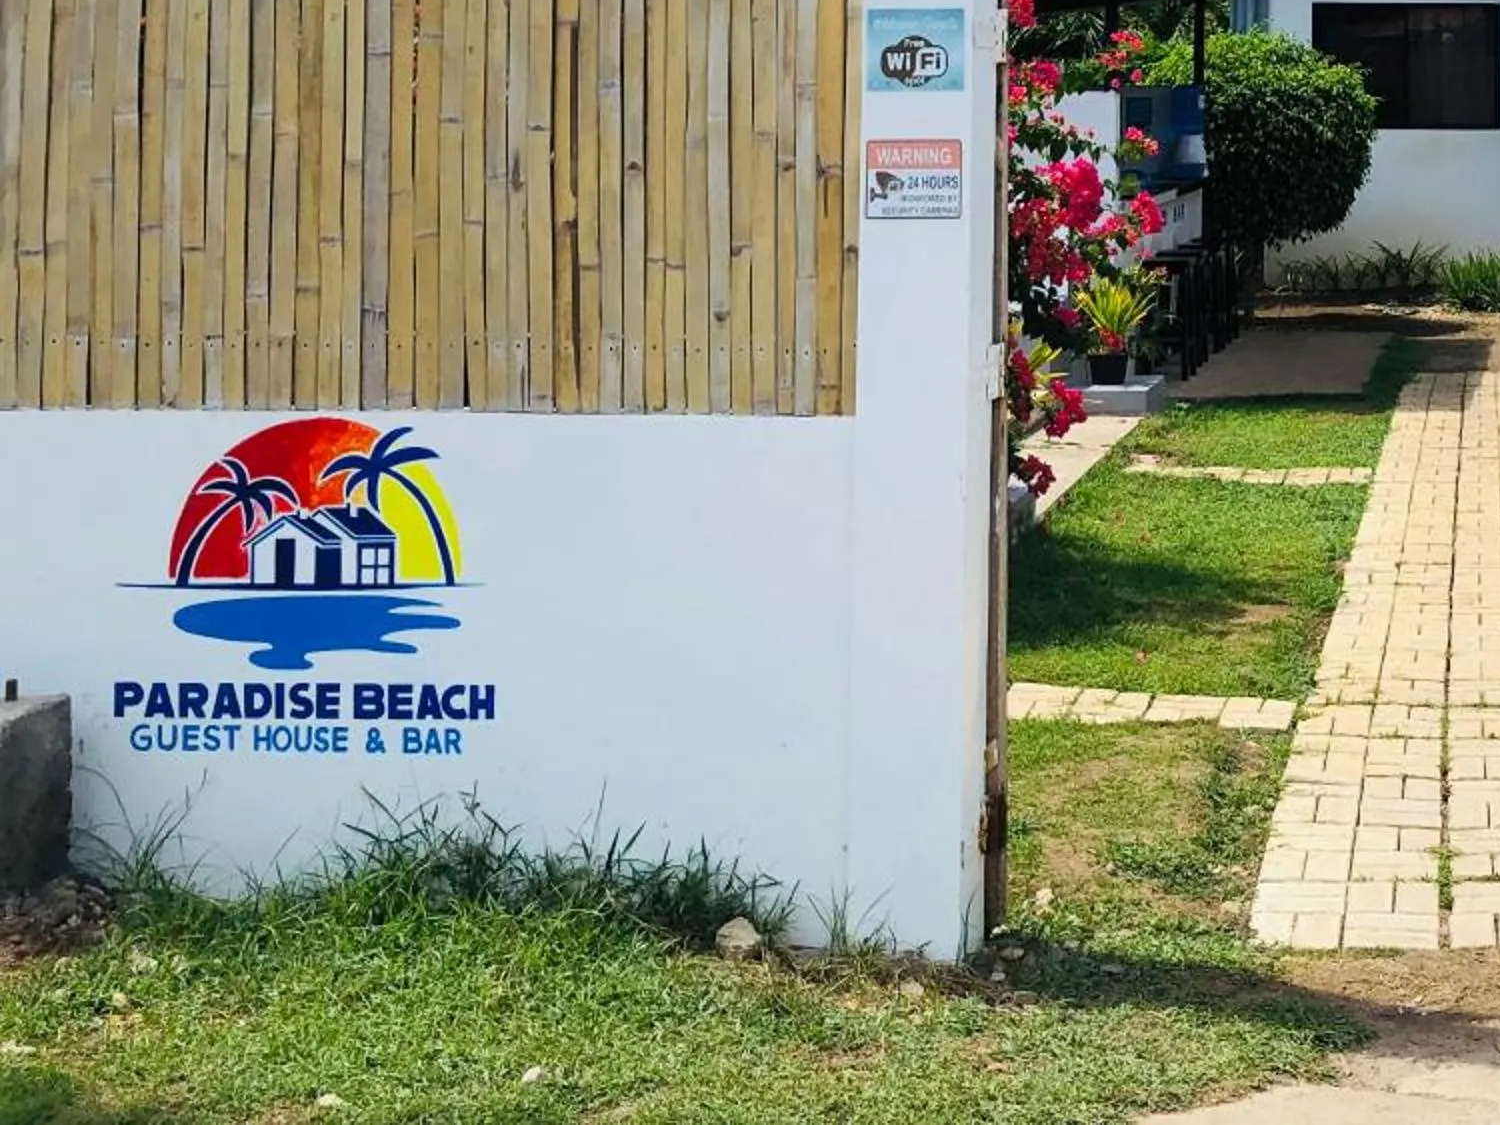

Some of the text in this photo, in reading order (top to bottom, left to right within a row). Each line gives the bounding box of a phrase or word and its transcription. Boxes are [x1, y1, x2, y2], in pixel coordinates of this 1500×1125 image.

[875, 147, 952, 165] WARNING
[907, 176, 959, 190] 24 HOURS
[113, 682, 495, 720] PARADISE BEACH
[130, 724, 462, 754] GUEST HOUSE & BAR
